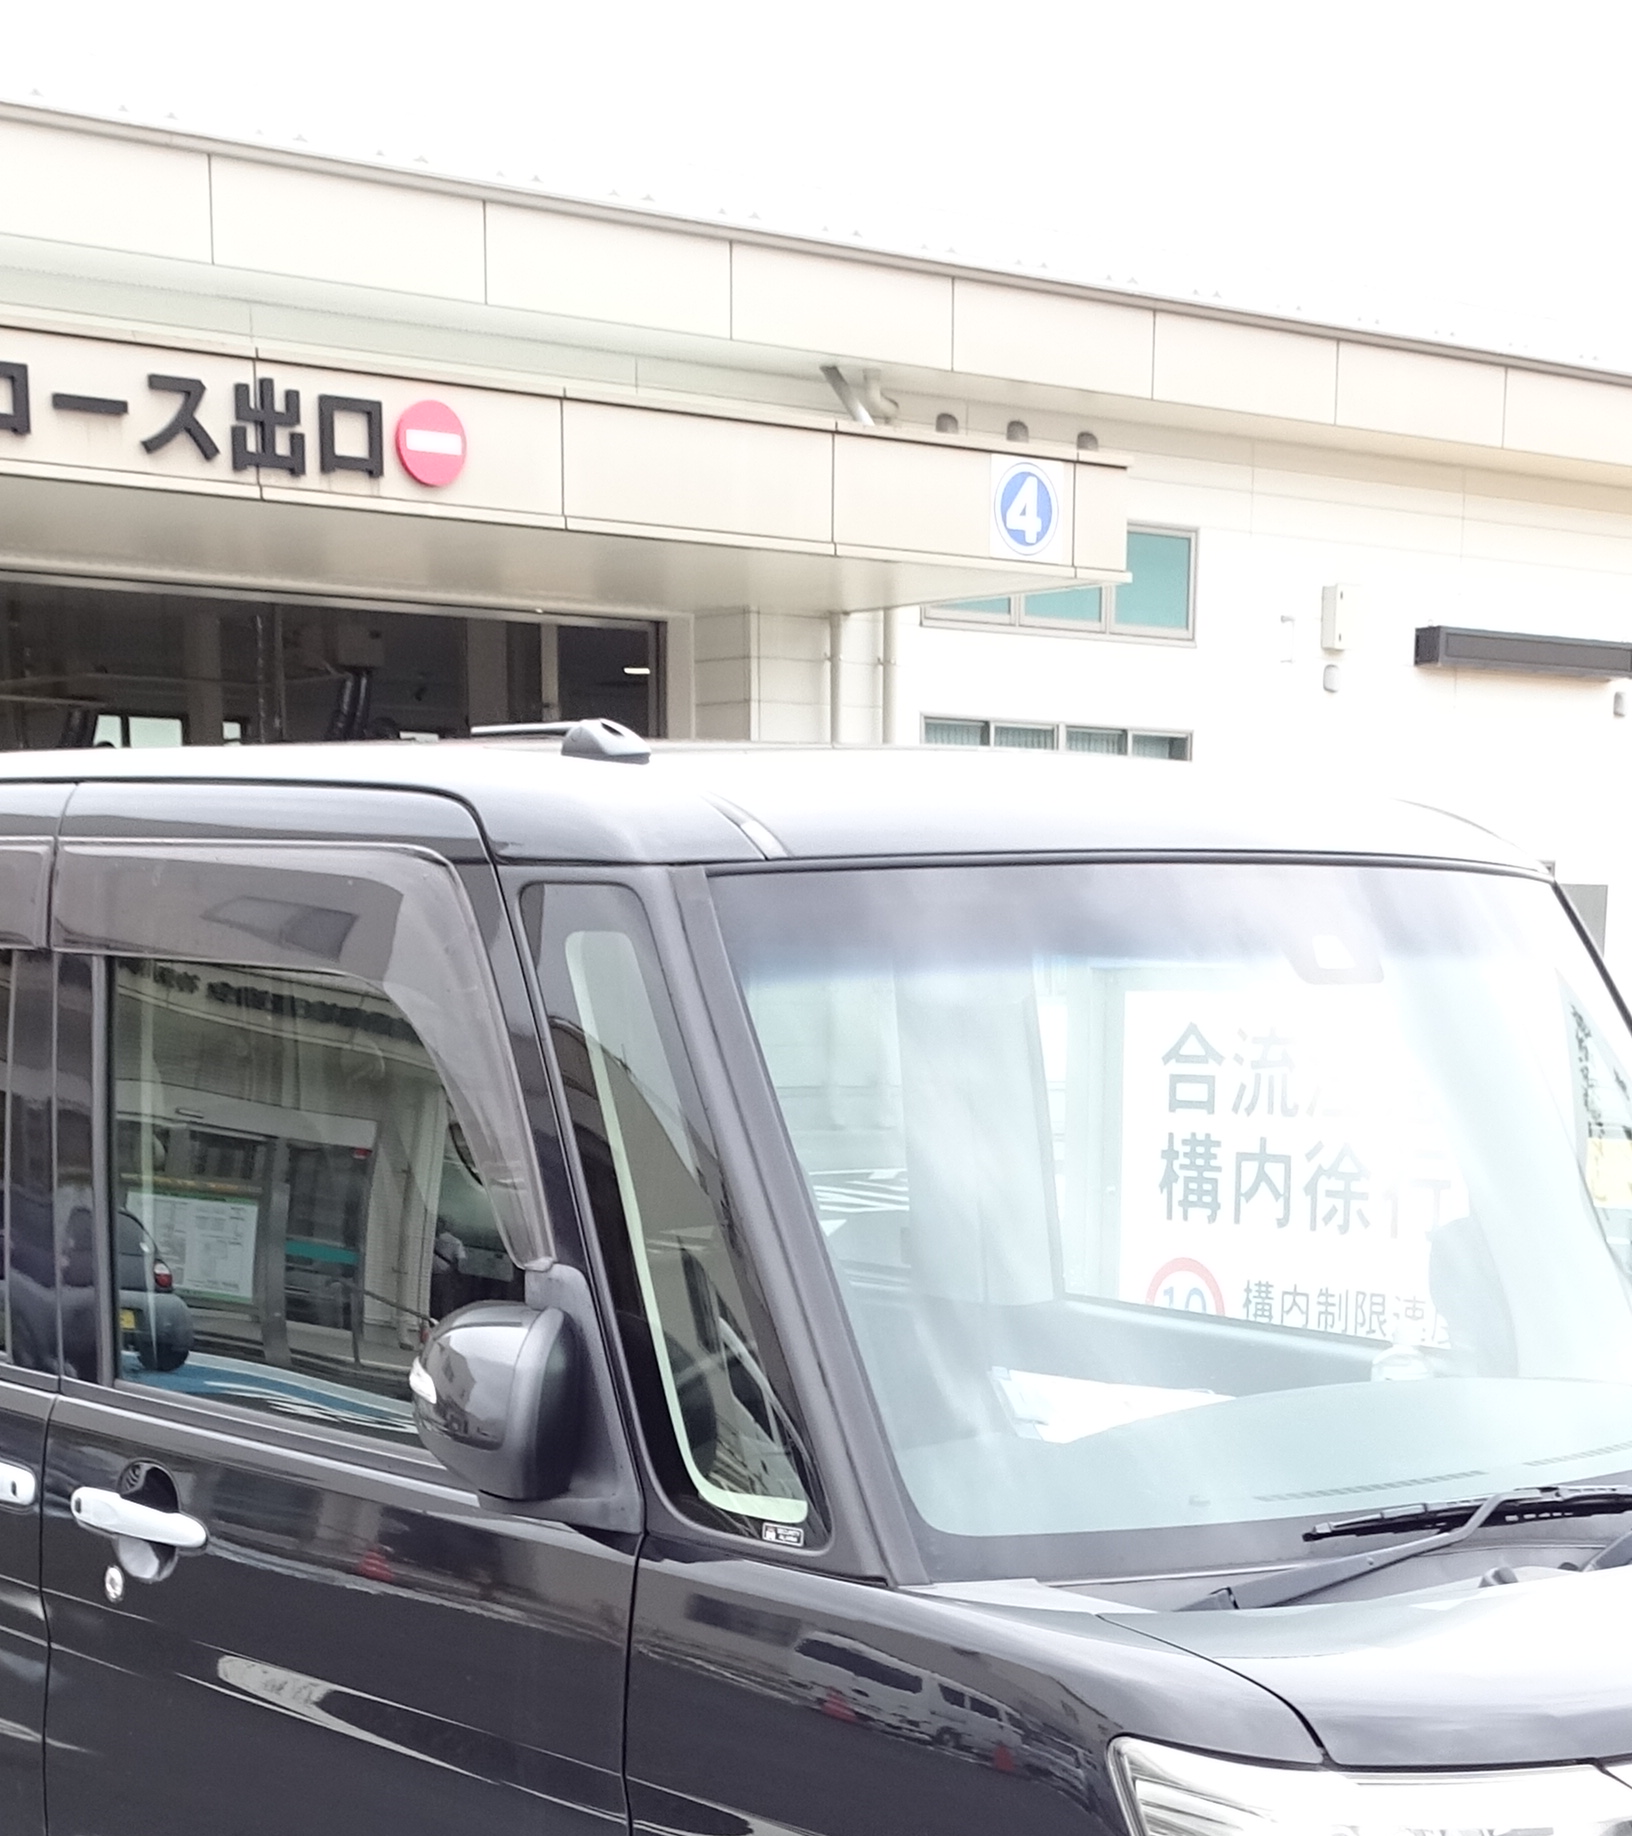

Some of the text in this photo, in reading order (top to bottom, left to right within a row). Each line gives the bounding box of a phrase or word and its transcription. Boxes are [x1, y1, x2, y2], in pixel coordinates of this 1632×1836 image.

[1005, 475, 1042, 545] 4
[1161, 1021, 1398, 1120] 合流
[1242, 1279, 1452, 1345] 構内制限速
